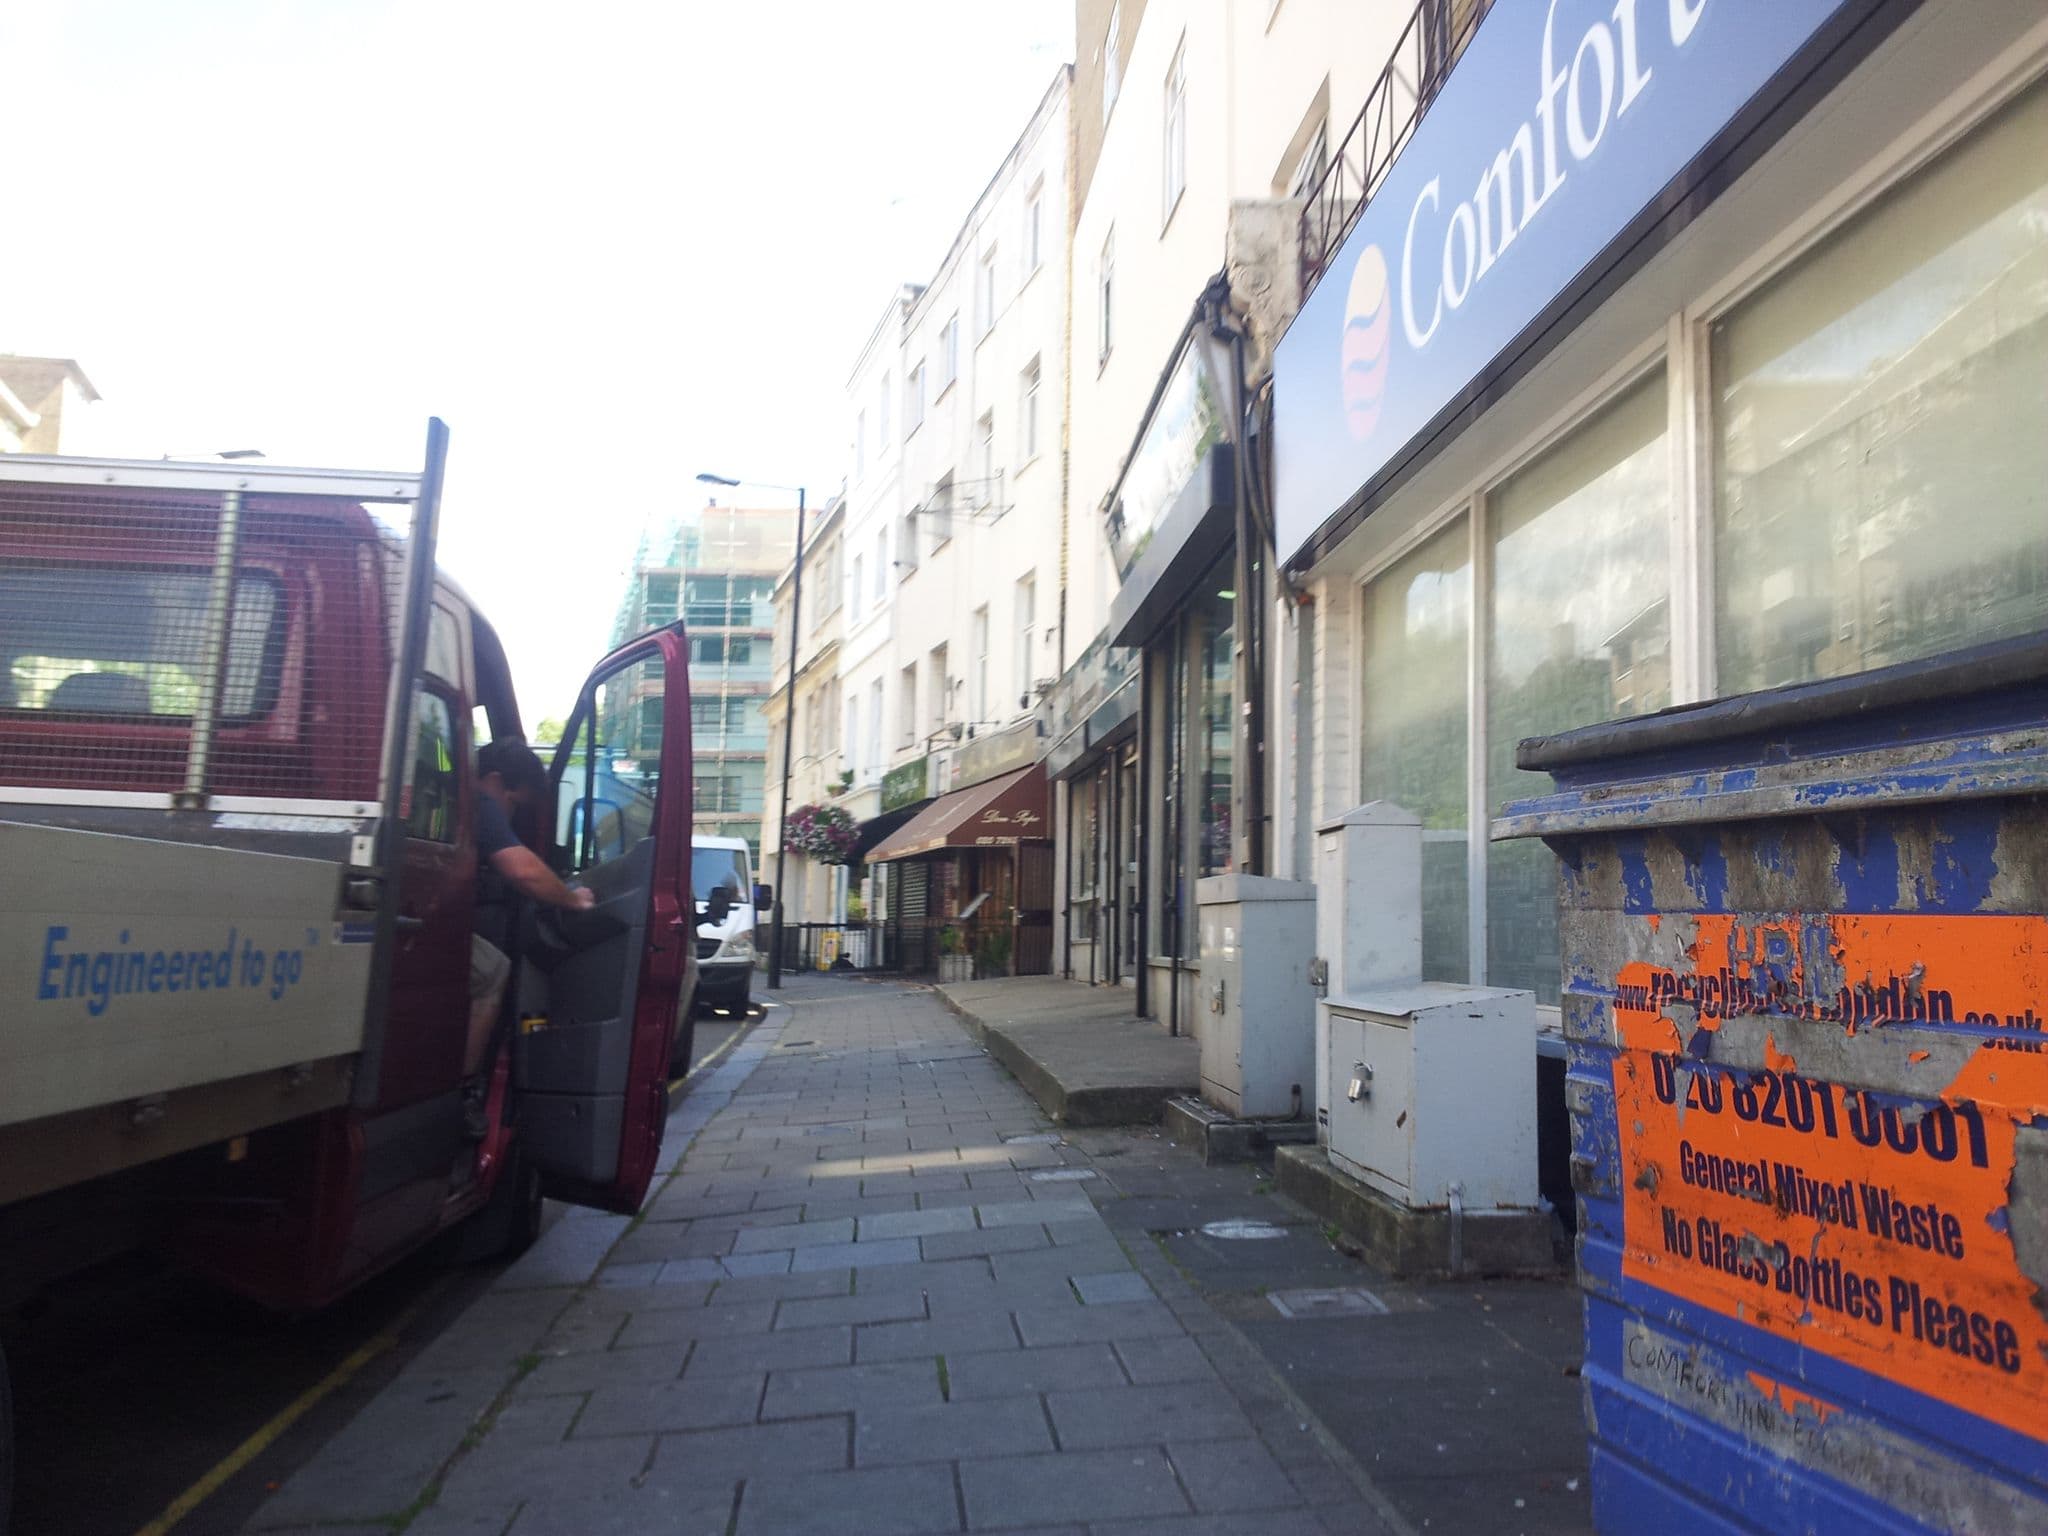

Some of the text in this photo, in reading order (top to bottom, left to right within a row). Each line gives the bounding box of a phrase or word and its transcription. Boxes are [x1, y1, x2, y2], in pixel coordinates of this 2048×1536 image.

[1401, 0, 1707, 349] Comfor
[37, 926, 303, 1016] Engineered to go
[1680, 1139, 1965, 1261] General Mixed Waste
[1661, 1205, 1693, 1260] No
[1774, 1239, 1884, 1327] Bottles
[1888, 1275, 2021, 1374] Please
